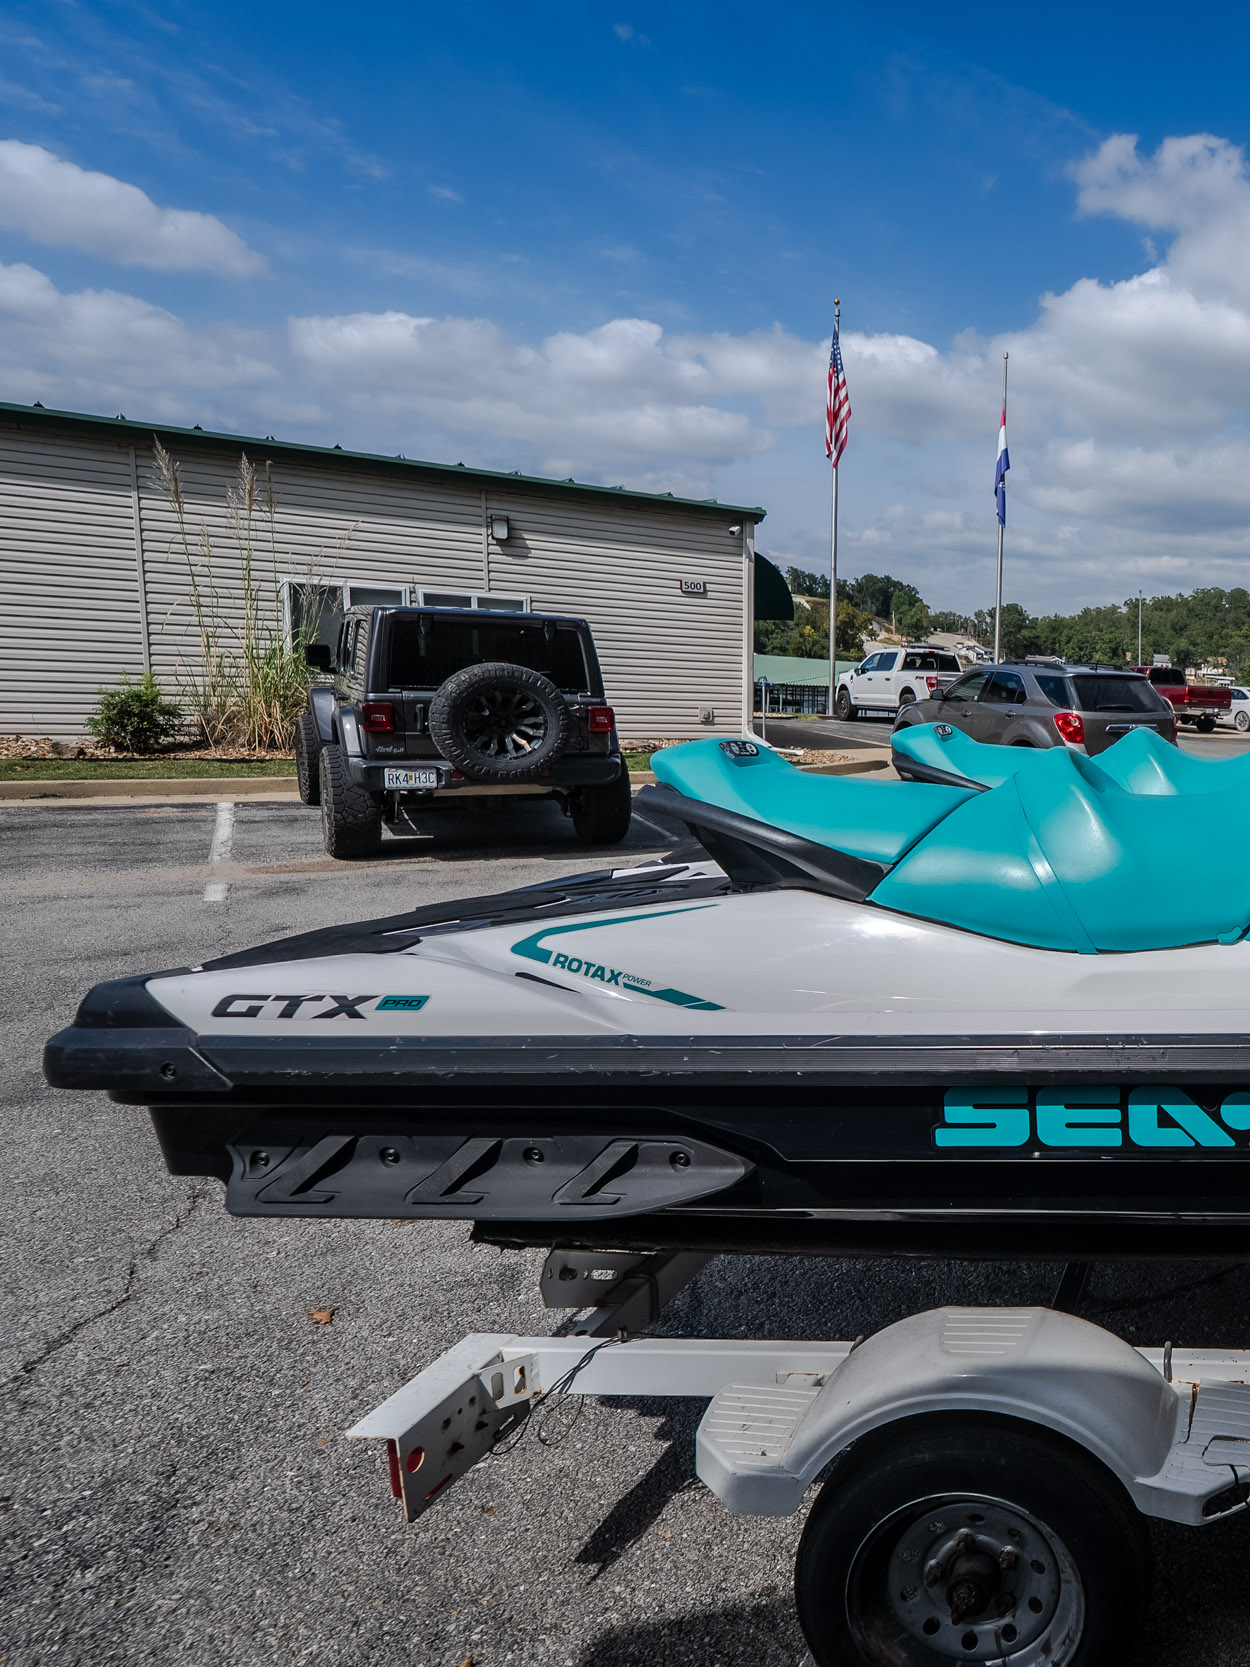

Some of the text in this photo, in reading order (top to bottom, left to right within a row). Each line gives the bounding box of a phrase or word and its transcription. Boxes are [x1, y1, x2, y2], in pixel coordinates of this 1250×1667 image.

[684, 581, 702, 590] 500
[552, 952, 652, 987] ROTAX POWER
[211, 994, 423, 1020] GTX PRO
